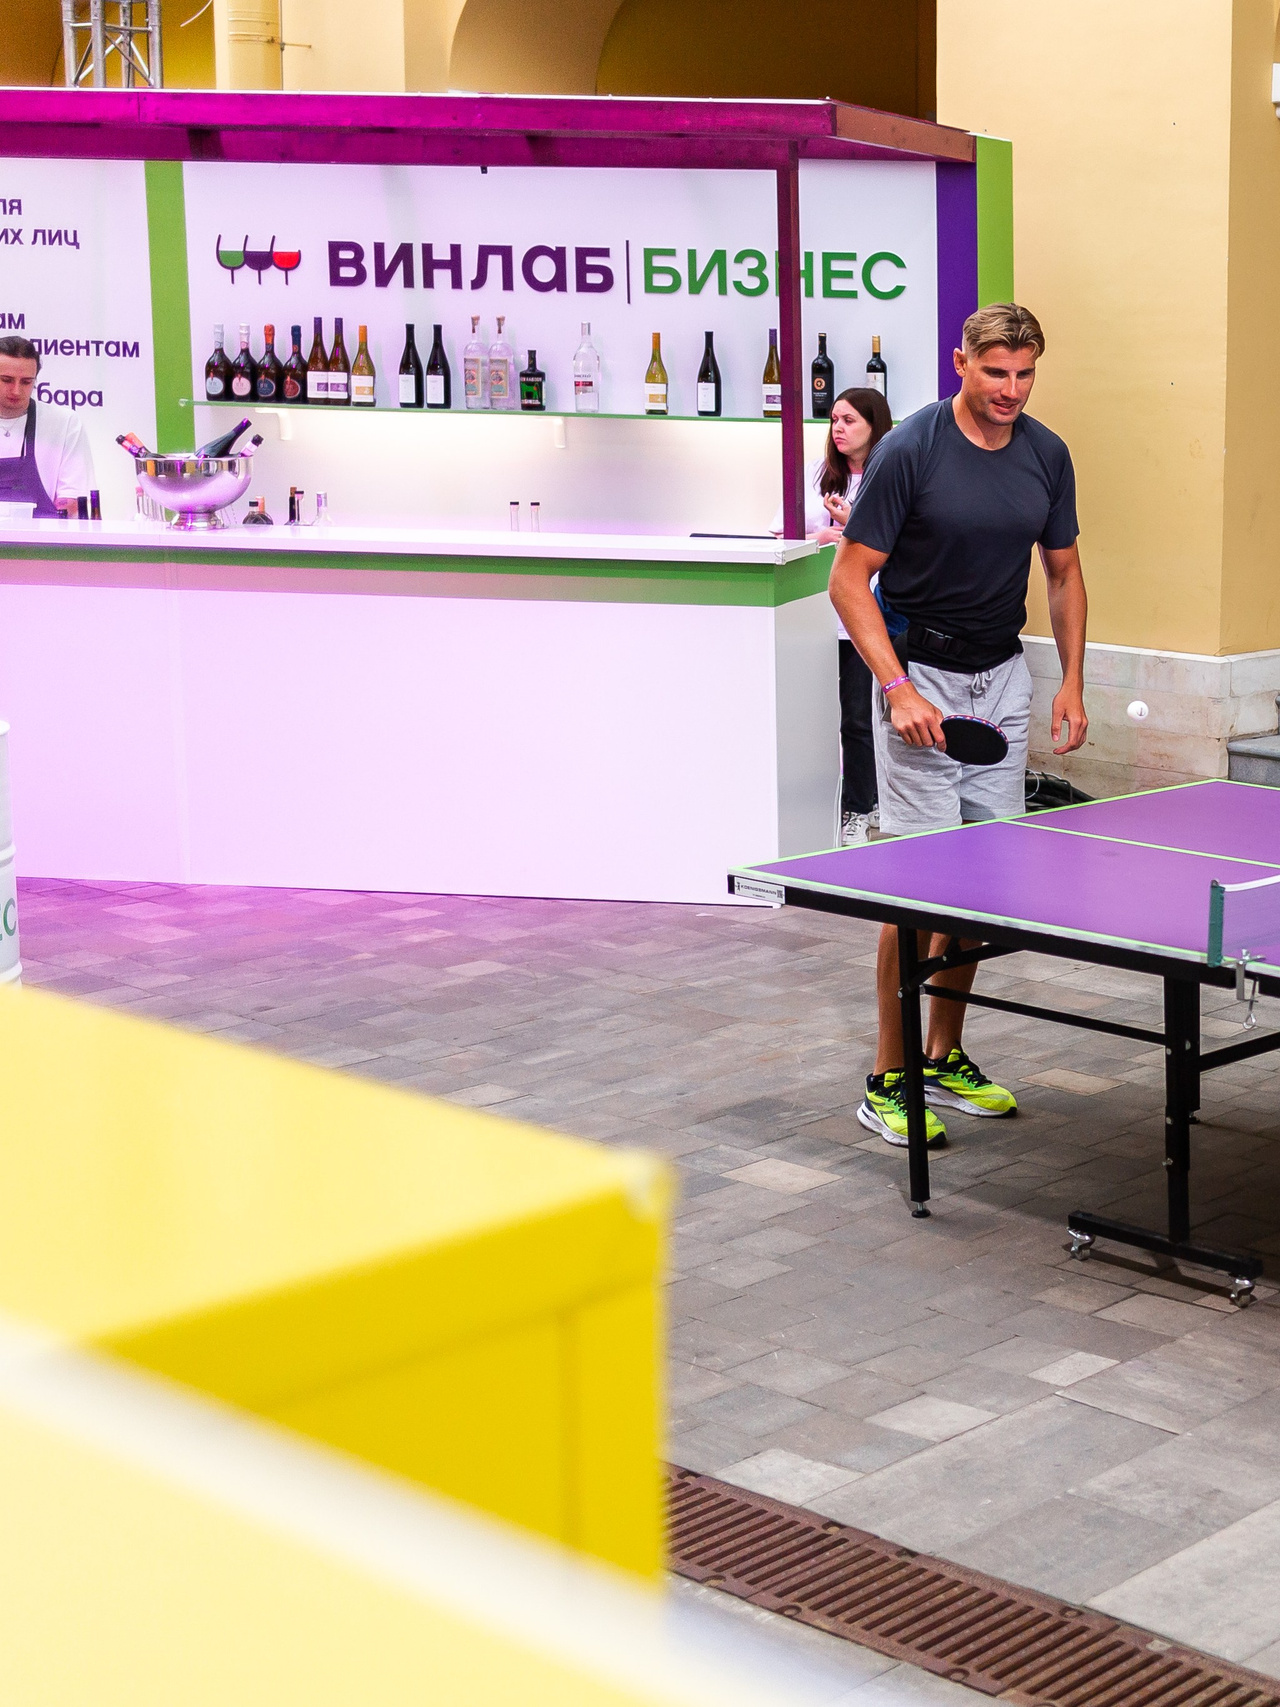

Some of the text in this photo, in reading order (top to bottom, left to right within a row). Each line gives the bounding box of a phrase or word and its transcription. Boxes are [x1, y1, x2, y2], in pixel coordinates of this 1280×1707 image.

[31, 229, 80, 249] лиц
[37, 382, 103, 411] бара
[0, 897, 17, 942] С
